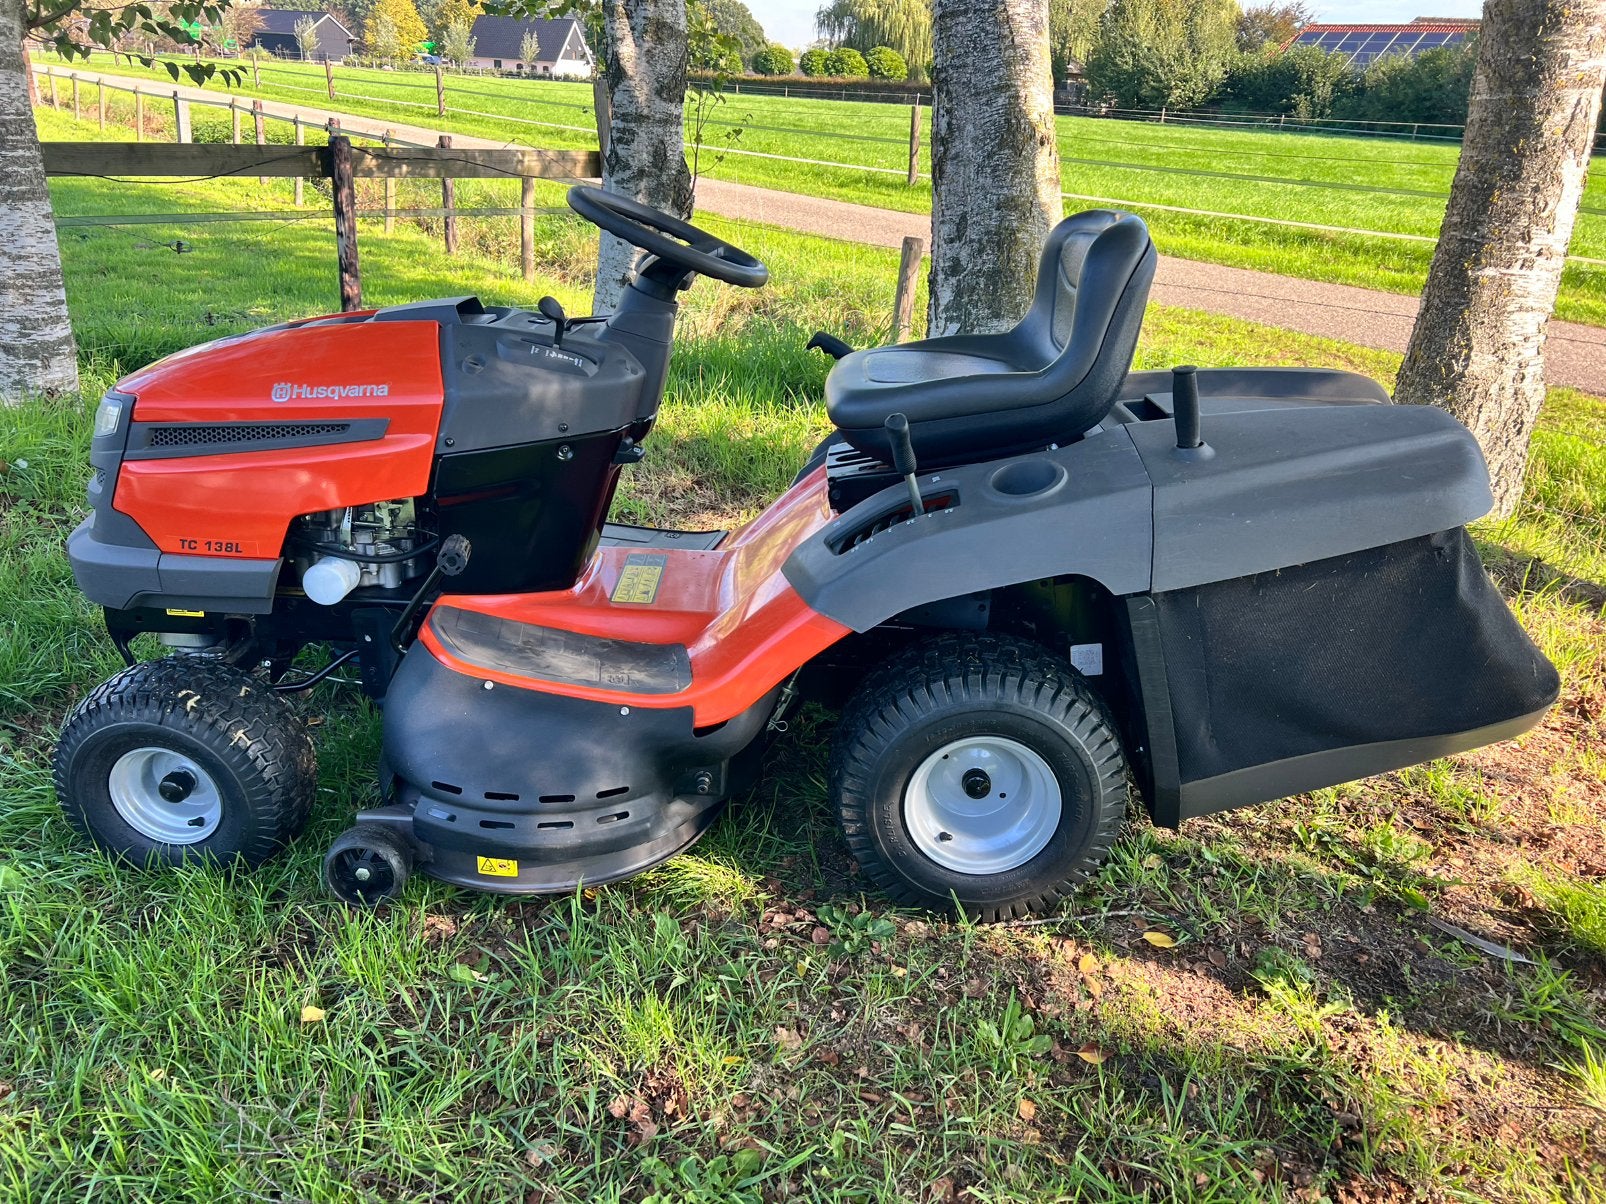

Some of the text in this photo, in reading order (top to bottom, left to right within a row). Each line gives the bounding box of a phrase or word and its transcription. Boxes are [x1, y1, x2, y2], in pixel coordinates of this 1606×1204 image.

[292, 384, 389, 400] Husqvarna
[179, 538, 243, 554] TC 138L
